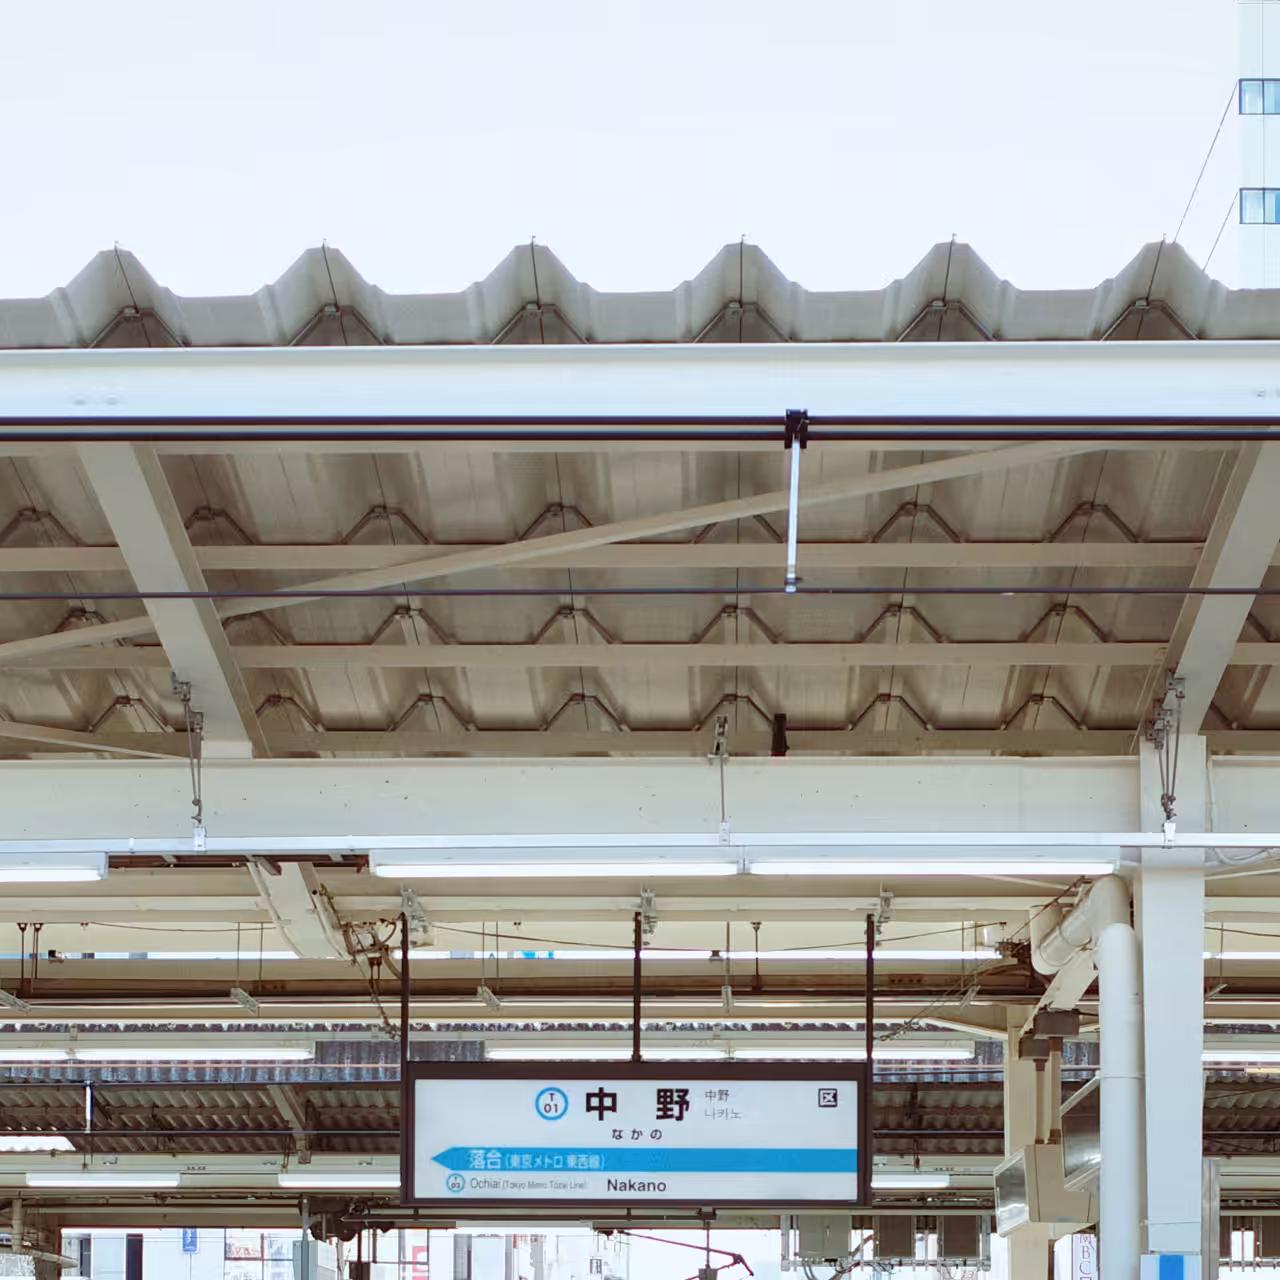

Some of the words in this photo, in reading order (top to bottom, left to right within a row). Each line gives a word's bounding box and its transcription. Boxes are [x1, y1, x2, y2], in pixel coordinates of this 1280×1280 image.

[543, 1103, 560, 1114] 01
[612, 1128, 663, 1140] なかの
[470, 1150, 502, 1169] 落合
[607, 1179, 667, 1193] Nakano
